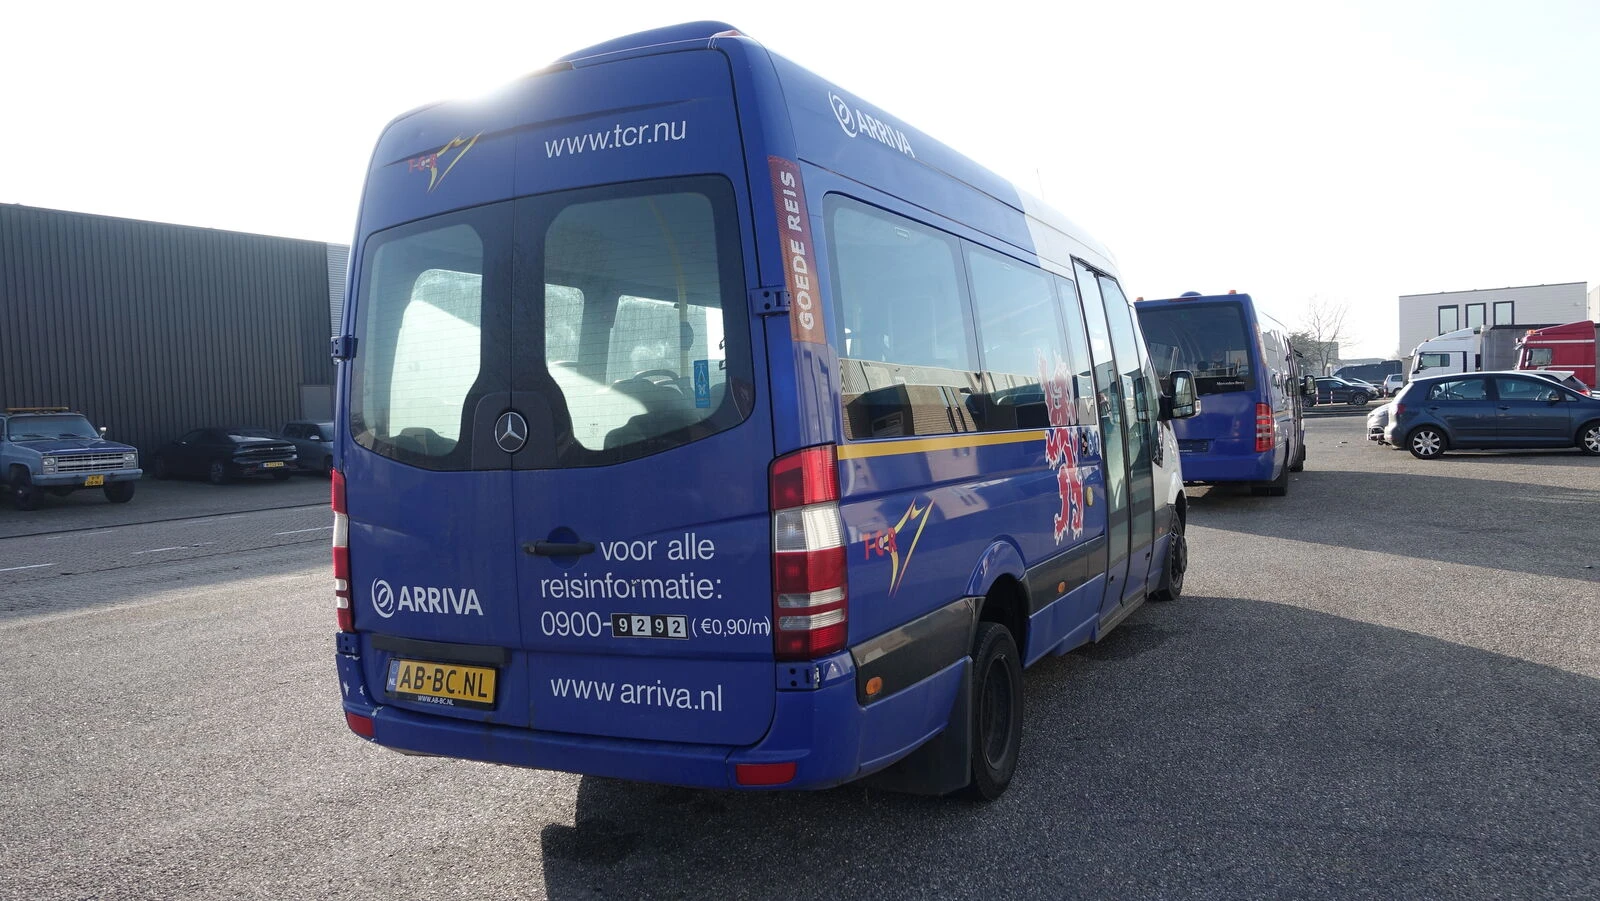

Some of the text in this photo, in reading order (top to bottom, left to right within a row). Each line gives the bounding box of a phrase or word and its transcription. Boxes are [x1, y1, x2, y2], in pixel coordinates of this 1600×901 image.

[544, 120, 687, 158] www.tcr.nu
[856, 109, 915, 158] ARRIVA
[780, 170, 815, 330] GOEDE REIS
[600, 532, 715, 561] voor alle
[397, 585, 484, 616] ARRIVA
[541, 572, 722, 600] reisinformatie:
[399, 664, 488, 698] AB-BC.NL
